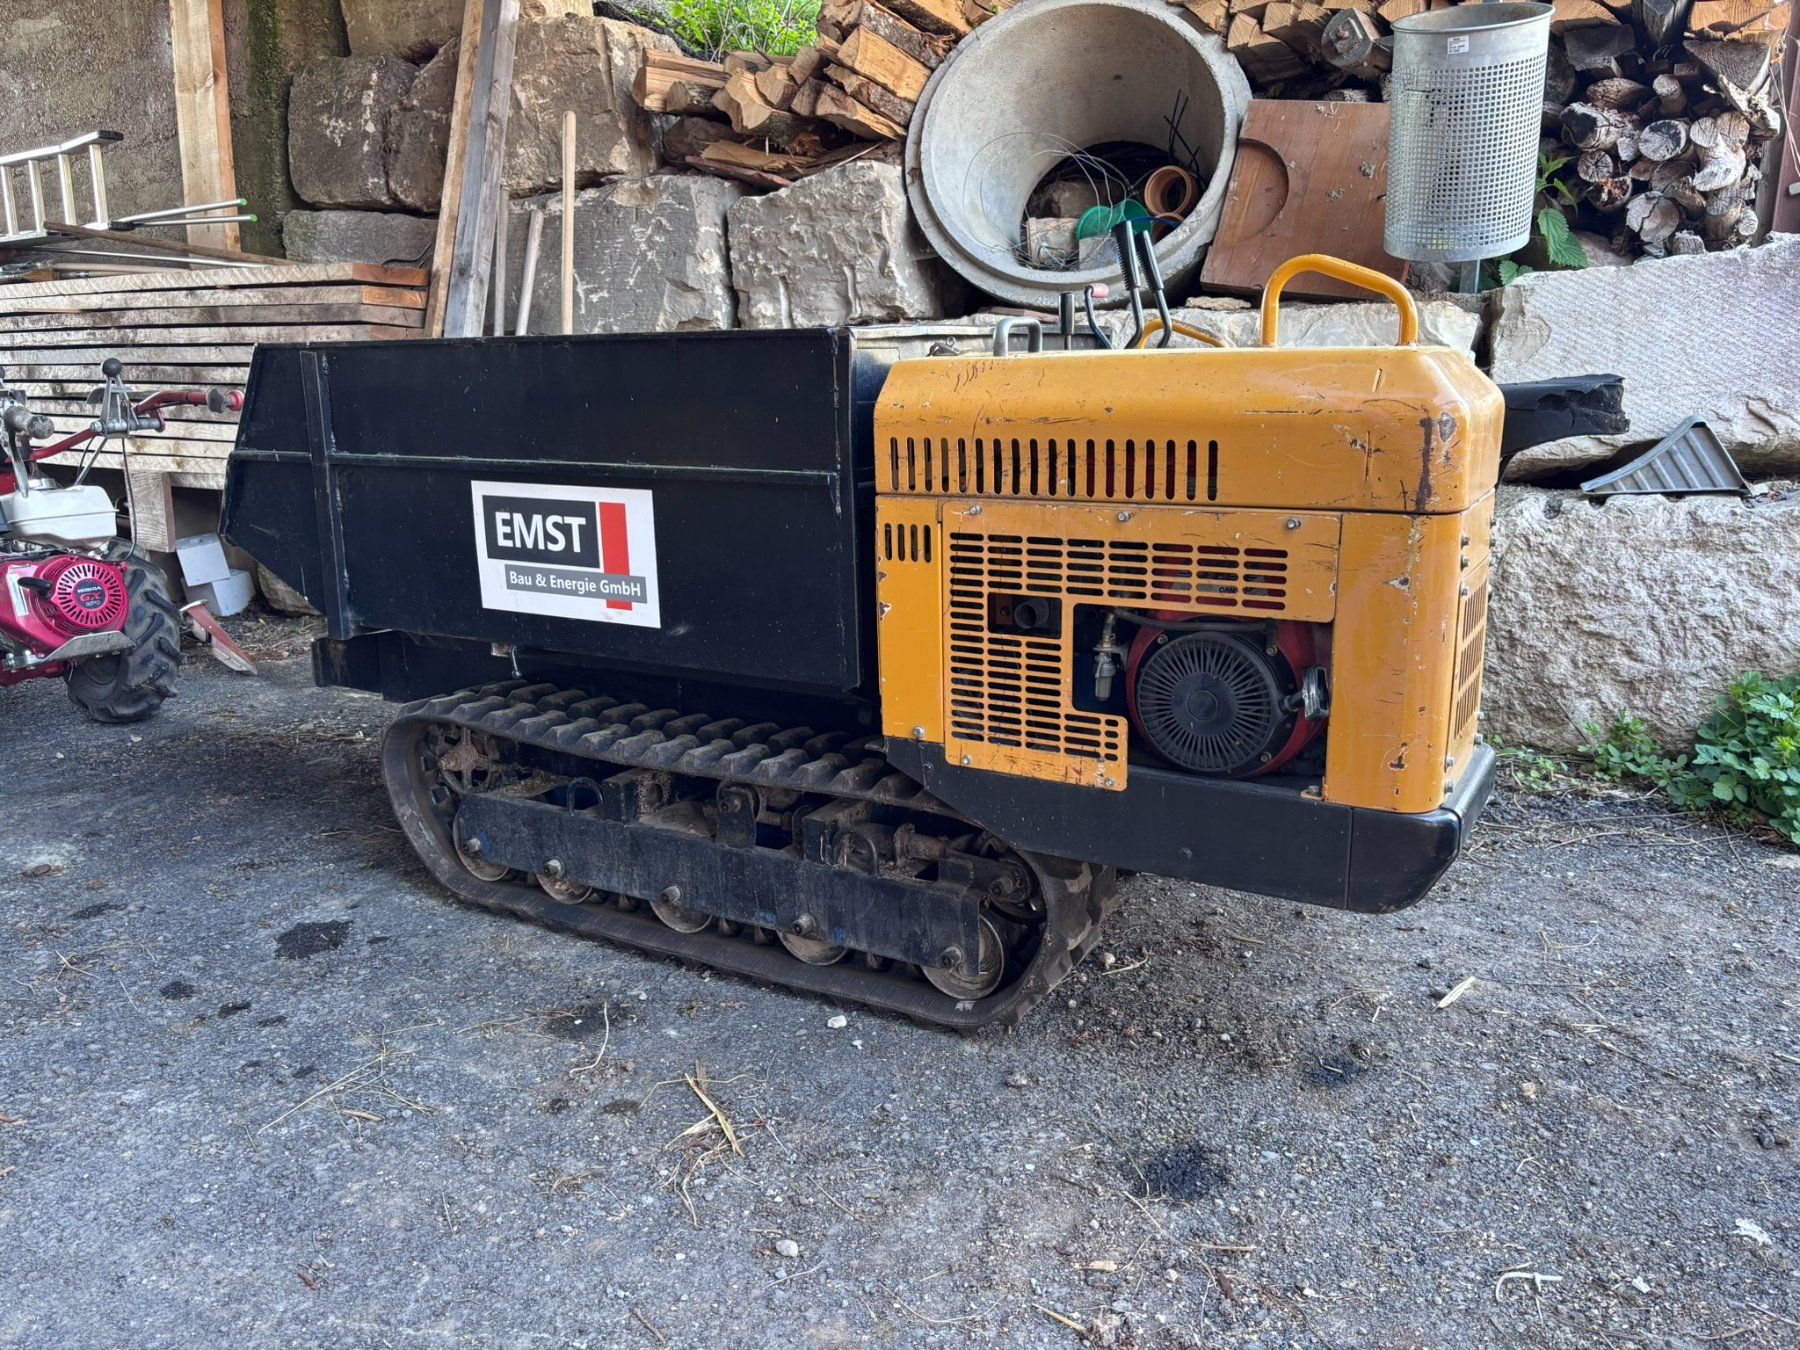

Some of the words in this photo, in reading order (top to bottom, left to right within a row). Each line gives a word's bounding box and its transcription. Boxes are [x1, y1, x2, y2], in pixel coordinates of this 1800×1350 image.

[495, 511, 586, 552] EMST
[509, 571, 532, 587] Bau
[535, 574, 547, 587] &
[549, 574, 597, 595] Energie
[600, 580, 641, 596] GmbH
